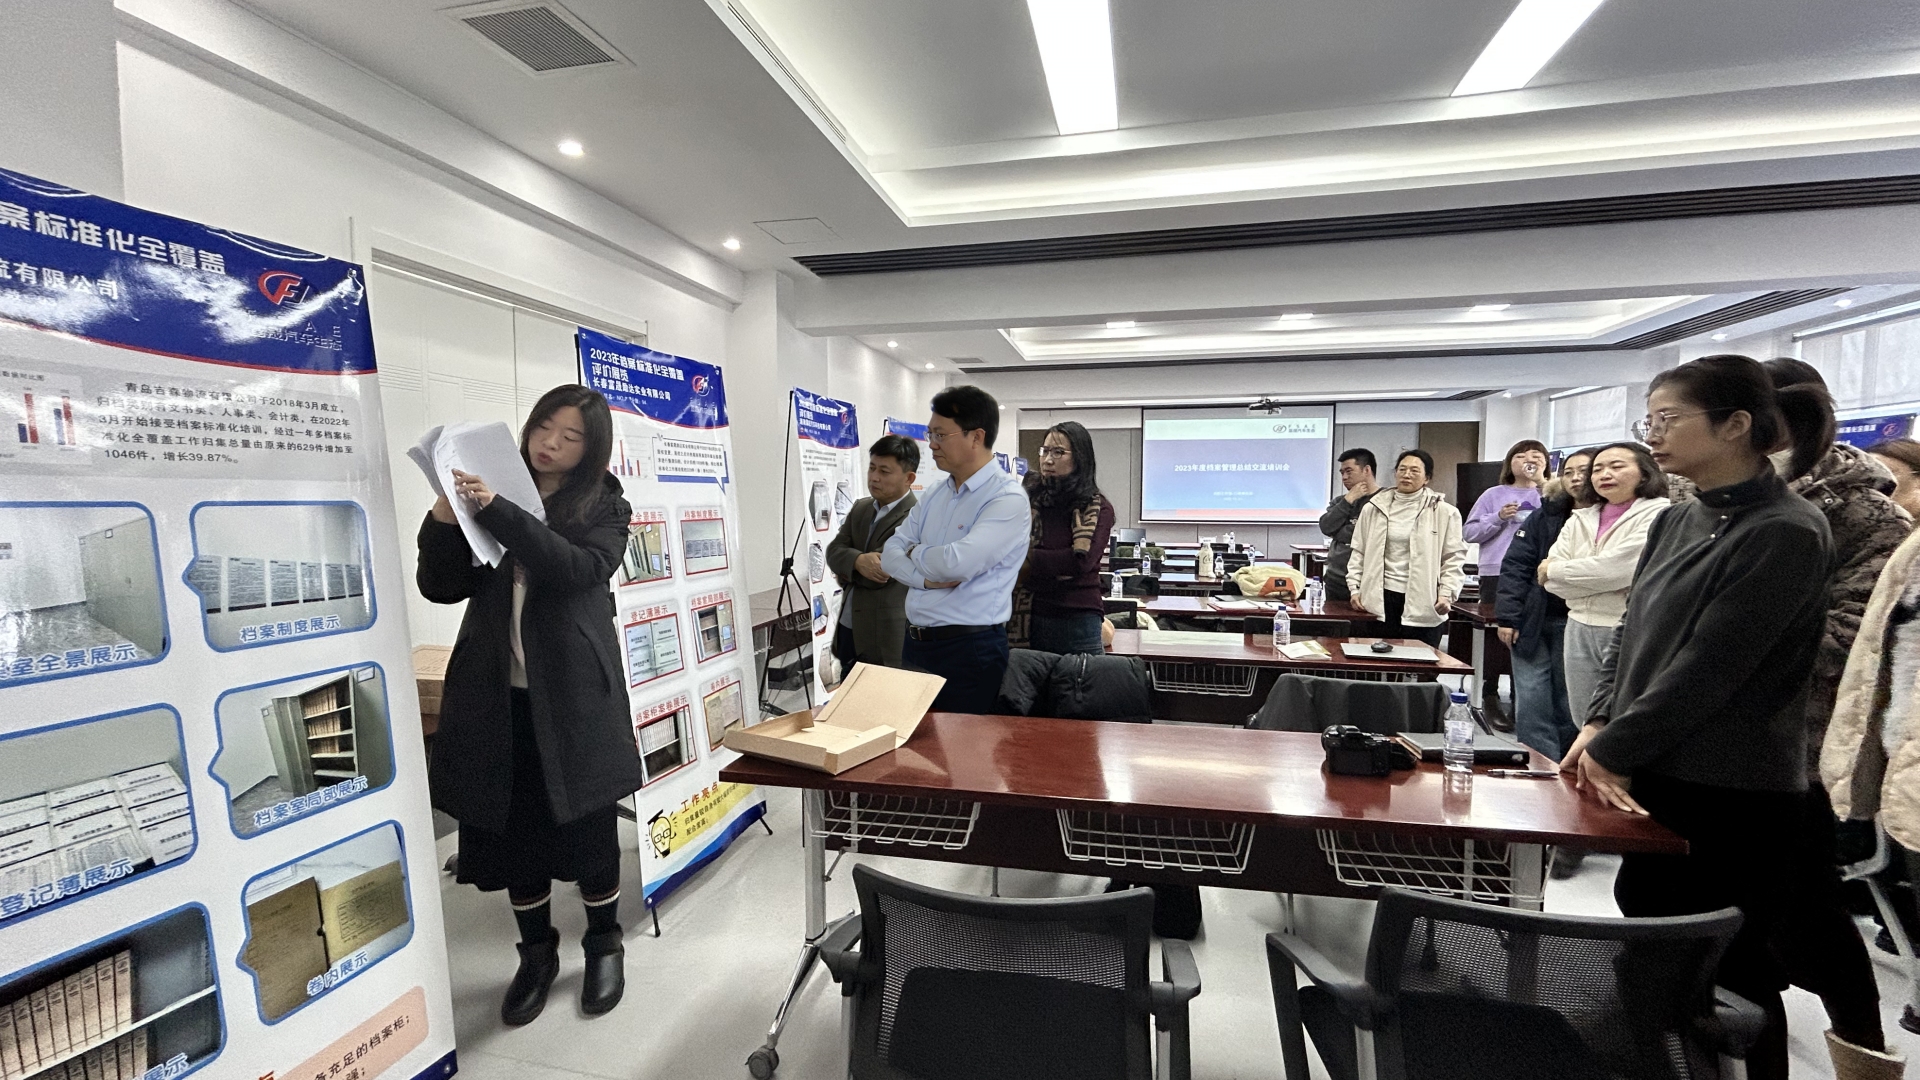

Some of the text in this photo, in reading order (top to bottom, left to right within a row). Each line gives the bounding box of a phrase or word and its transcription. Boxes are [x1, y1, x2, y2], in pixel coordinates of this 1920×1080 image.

[0, 201, 226, 275] 案标准化全覆盖
[240, 615, 341, 642] 档案制度展示
[254, 776, 369, 827] 档案室局部展示
[681, 781, 718, 814] 工作亮点
[308, 951, 368, 996] 卷内展示
